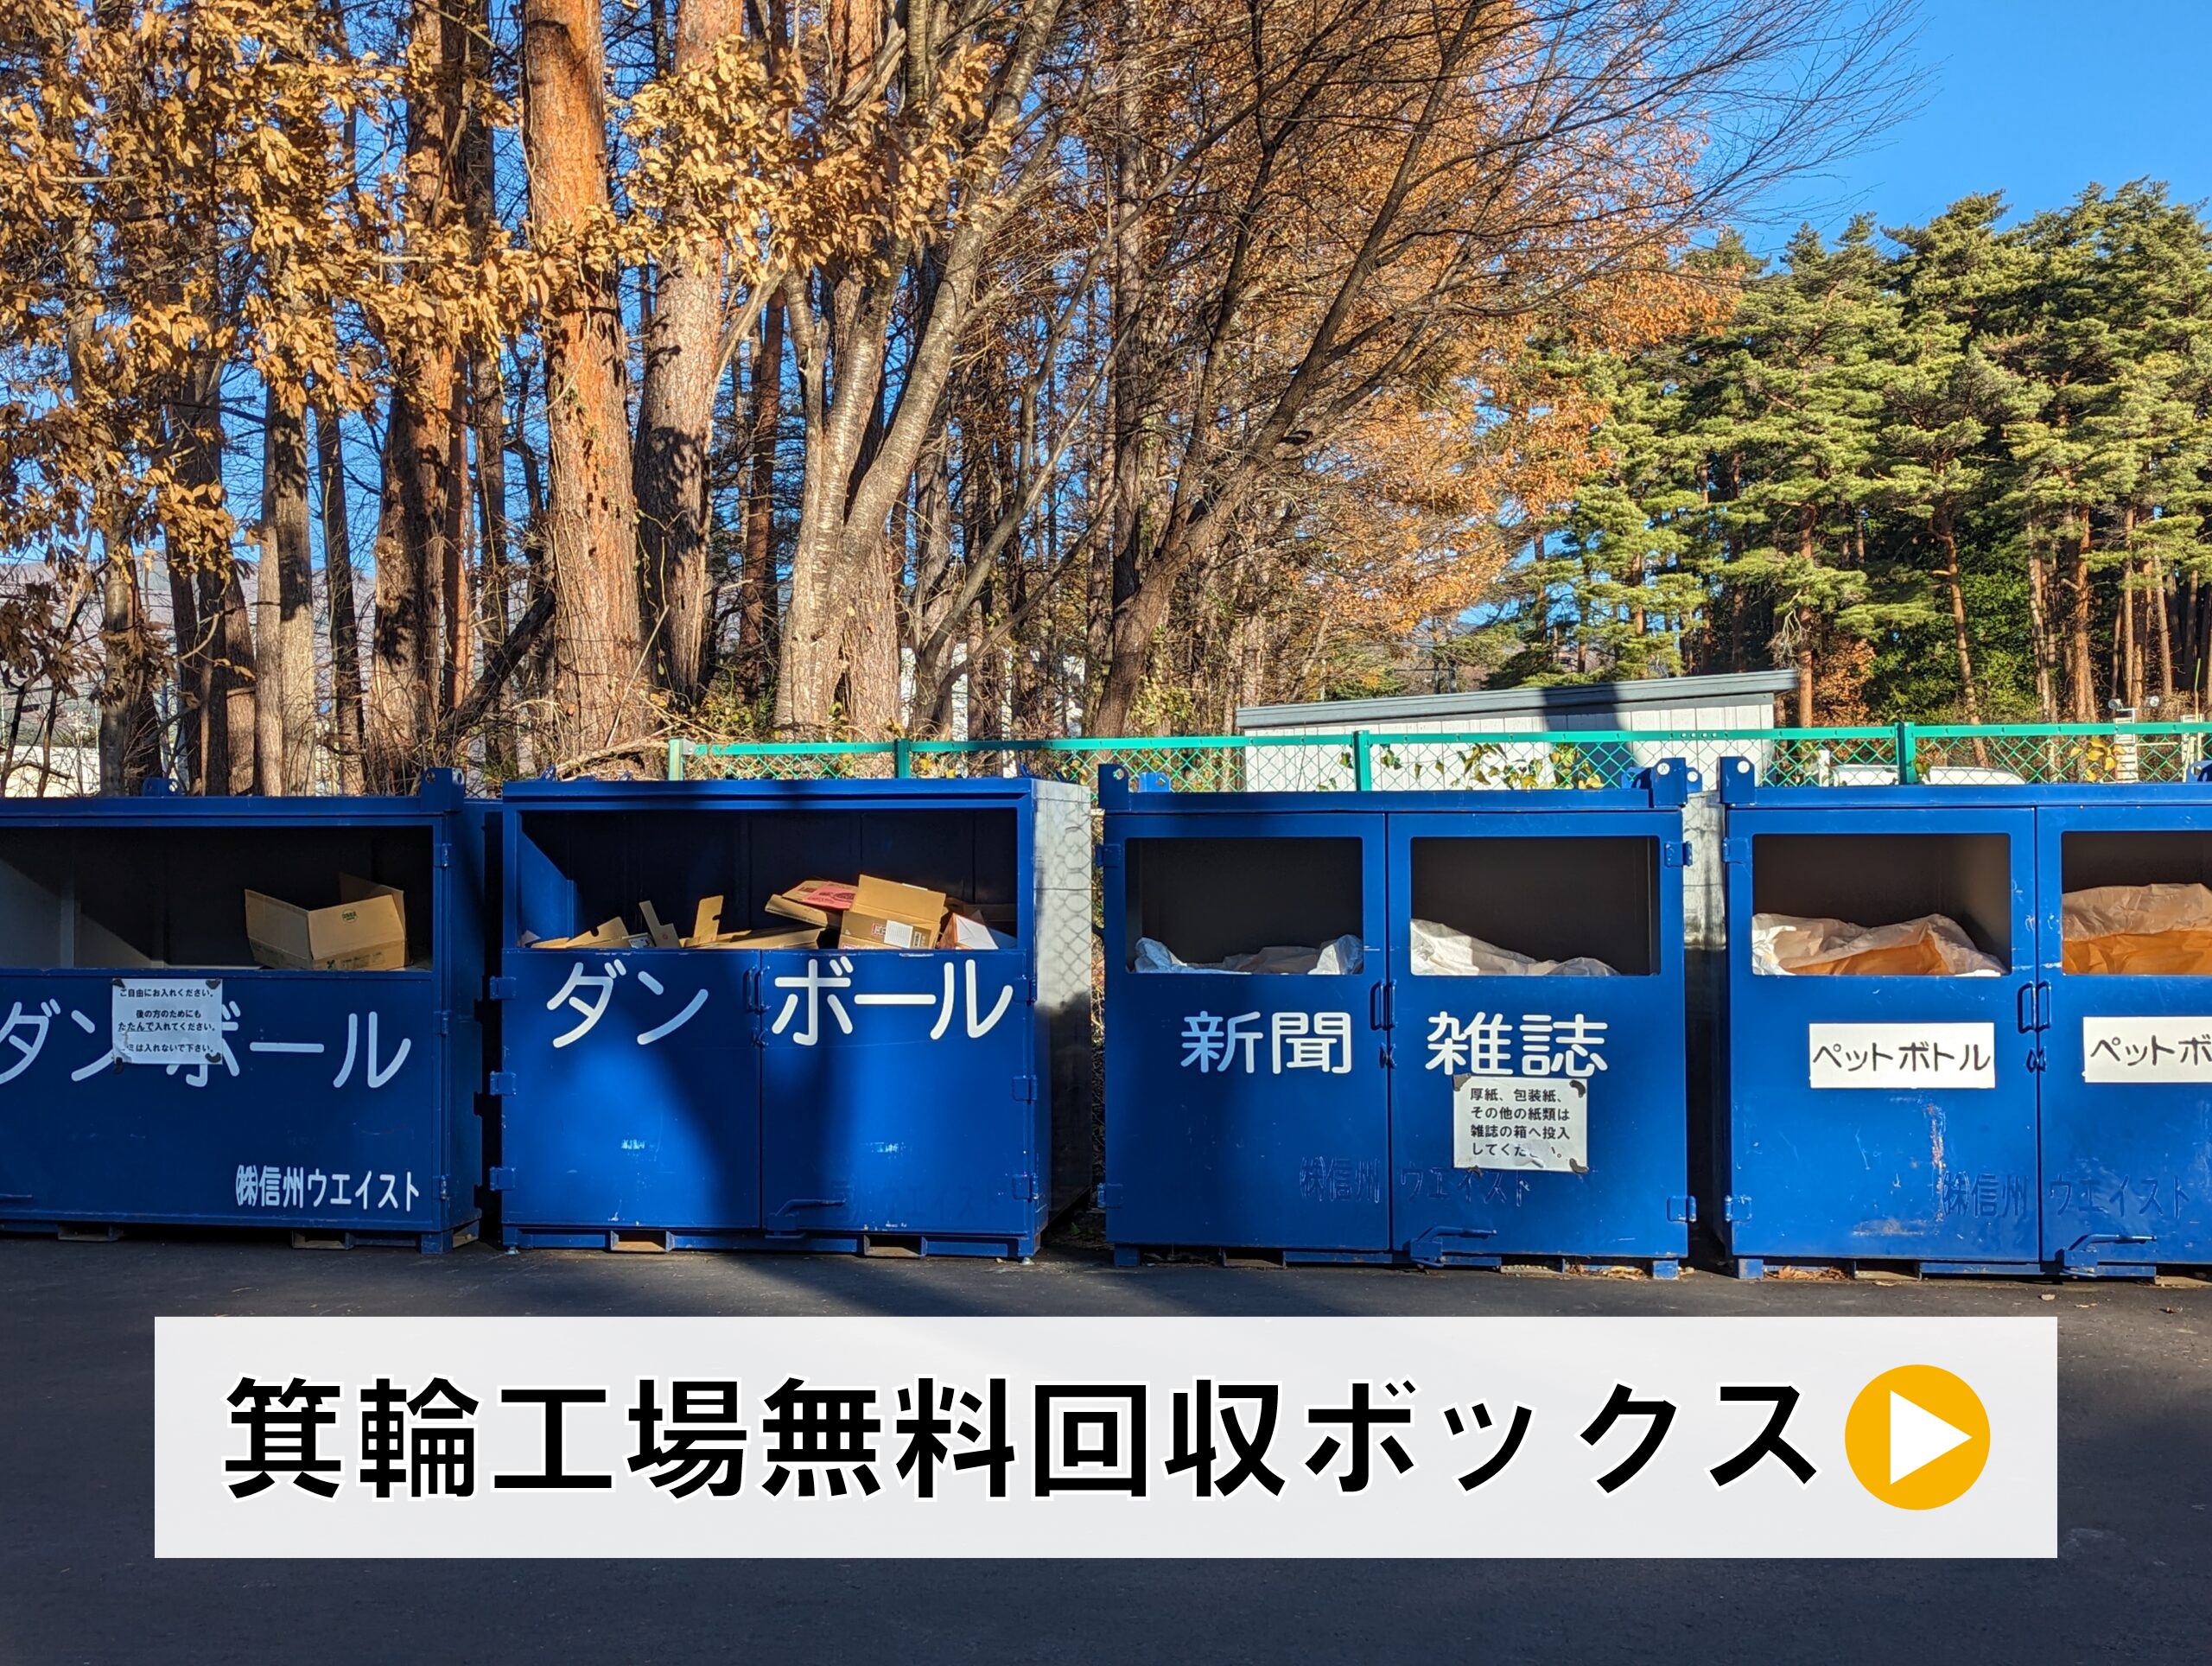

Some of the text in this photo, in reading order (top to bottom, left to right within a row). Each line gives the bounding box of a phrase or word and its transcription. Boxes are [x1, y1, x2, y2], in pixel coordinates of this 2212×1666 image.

[119, 989, 213, 998] ご自由にお入れください。
[546, 958, 1014, 1048] ダン ボール
[136, 1009, 201, 1019] 後の方のためにも
[118, 1021, 215, 1032] たたんで入れてください。
[121, 1043, 213, 1053] ミは入れないで下さい。
[1180, 1010, 1353, 1074] 新聞
[1424, 1011, 1609, 1077] 雑誌
[1813, 1041, 1991, 1071] ペットボトル
[1471, 1106, 1570, 1121] その他の紙類は
[1470, 1124, 1570, 1140] 雑誌の箱へ投入
